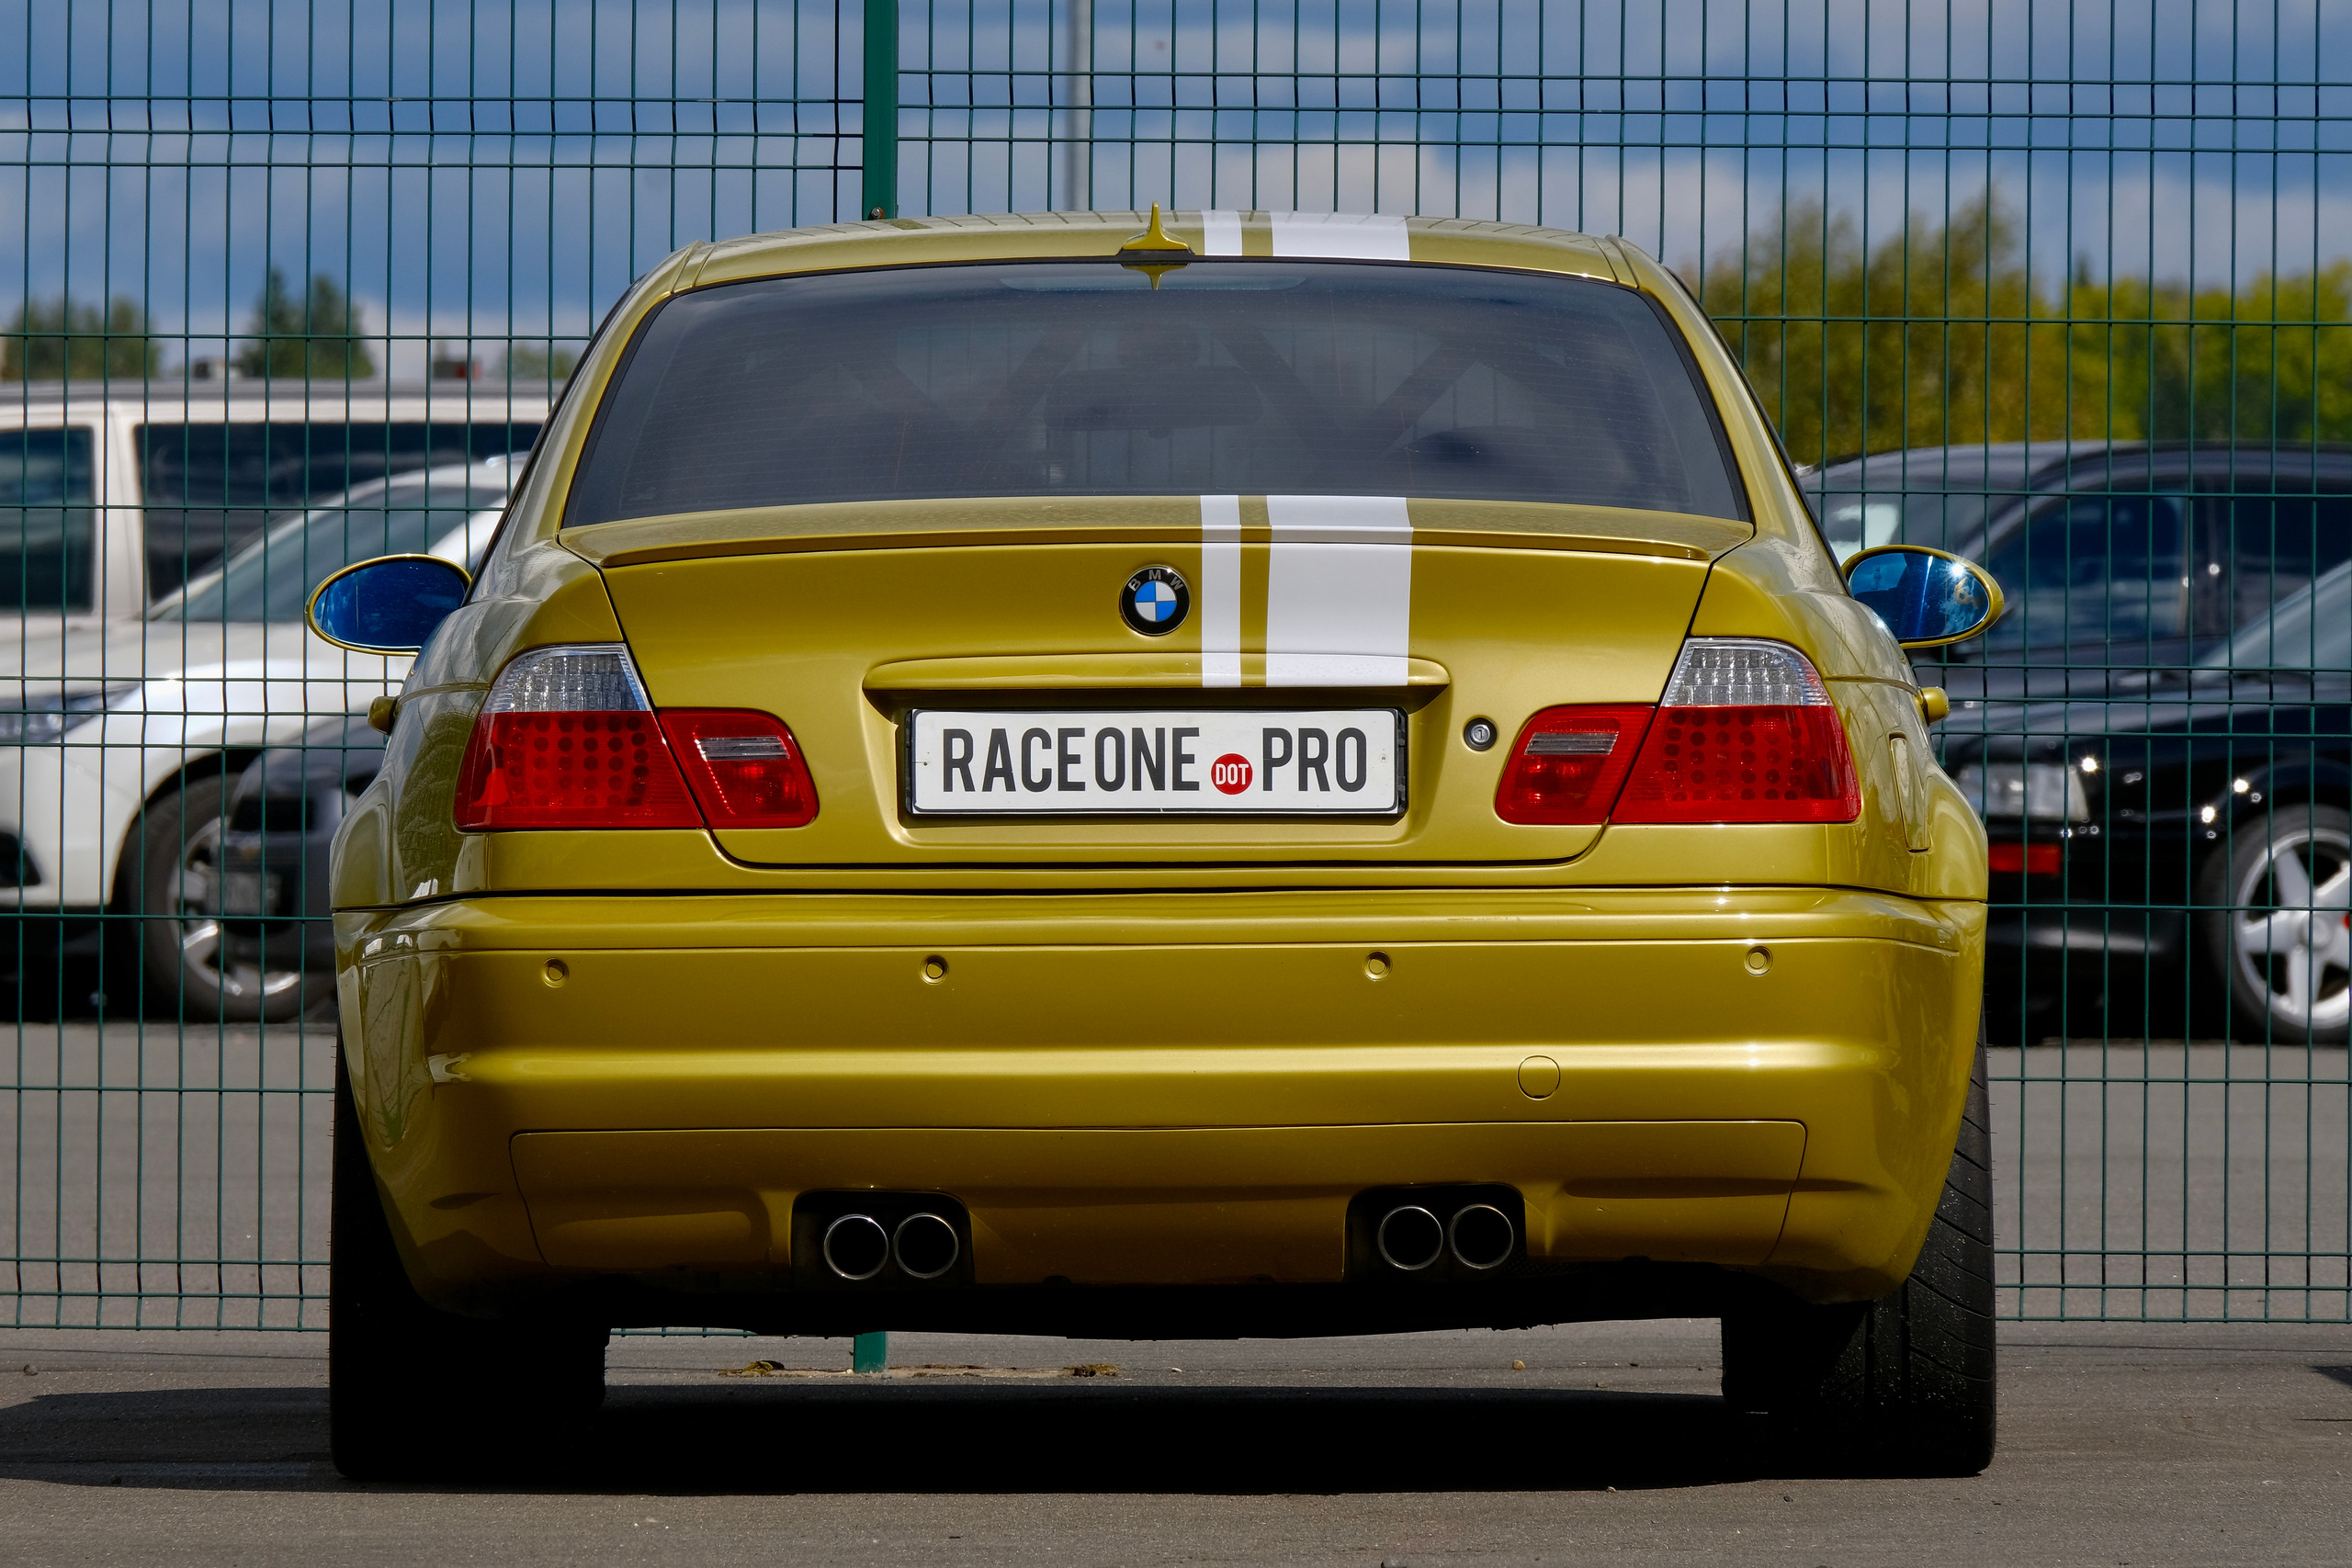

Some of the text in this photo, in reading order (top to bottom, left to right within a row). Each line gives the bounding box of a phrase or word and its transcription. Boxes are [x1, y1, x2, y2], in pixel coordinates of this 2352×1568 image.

[1127, 569, 1184, 592] BMW
[1216, 762, 1250, 786] DOT
[1263, 728, 1367, 792] PRO
